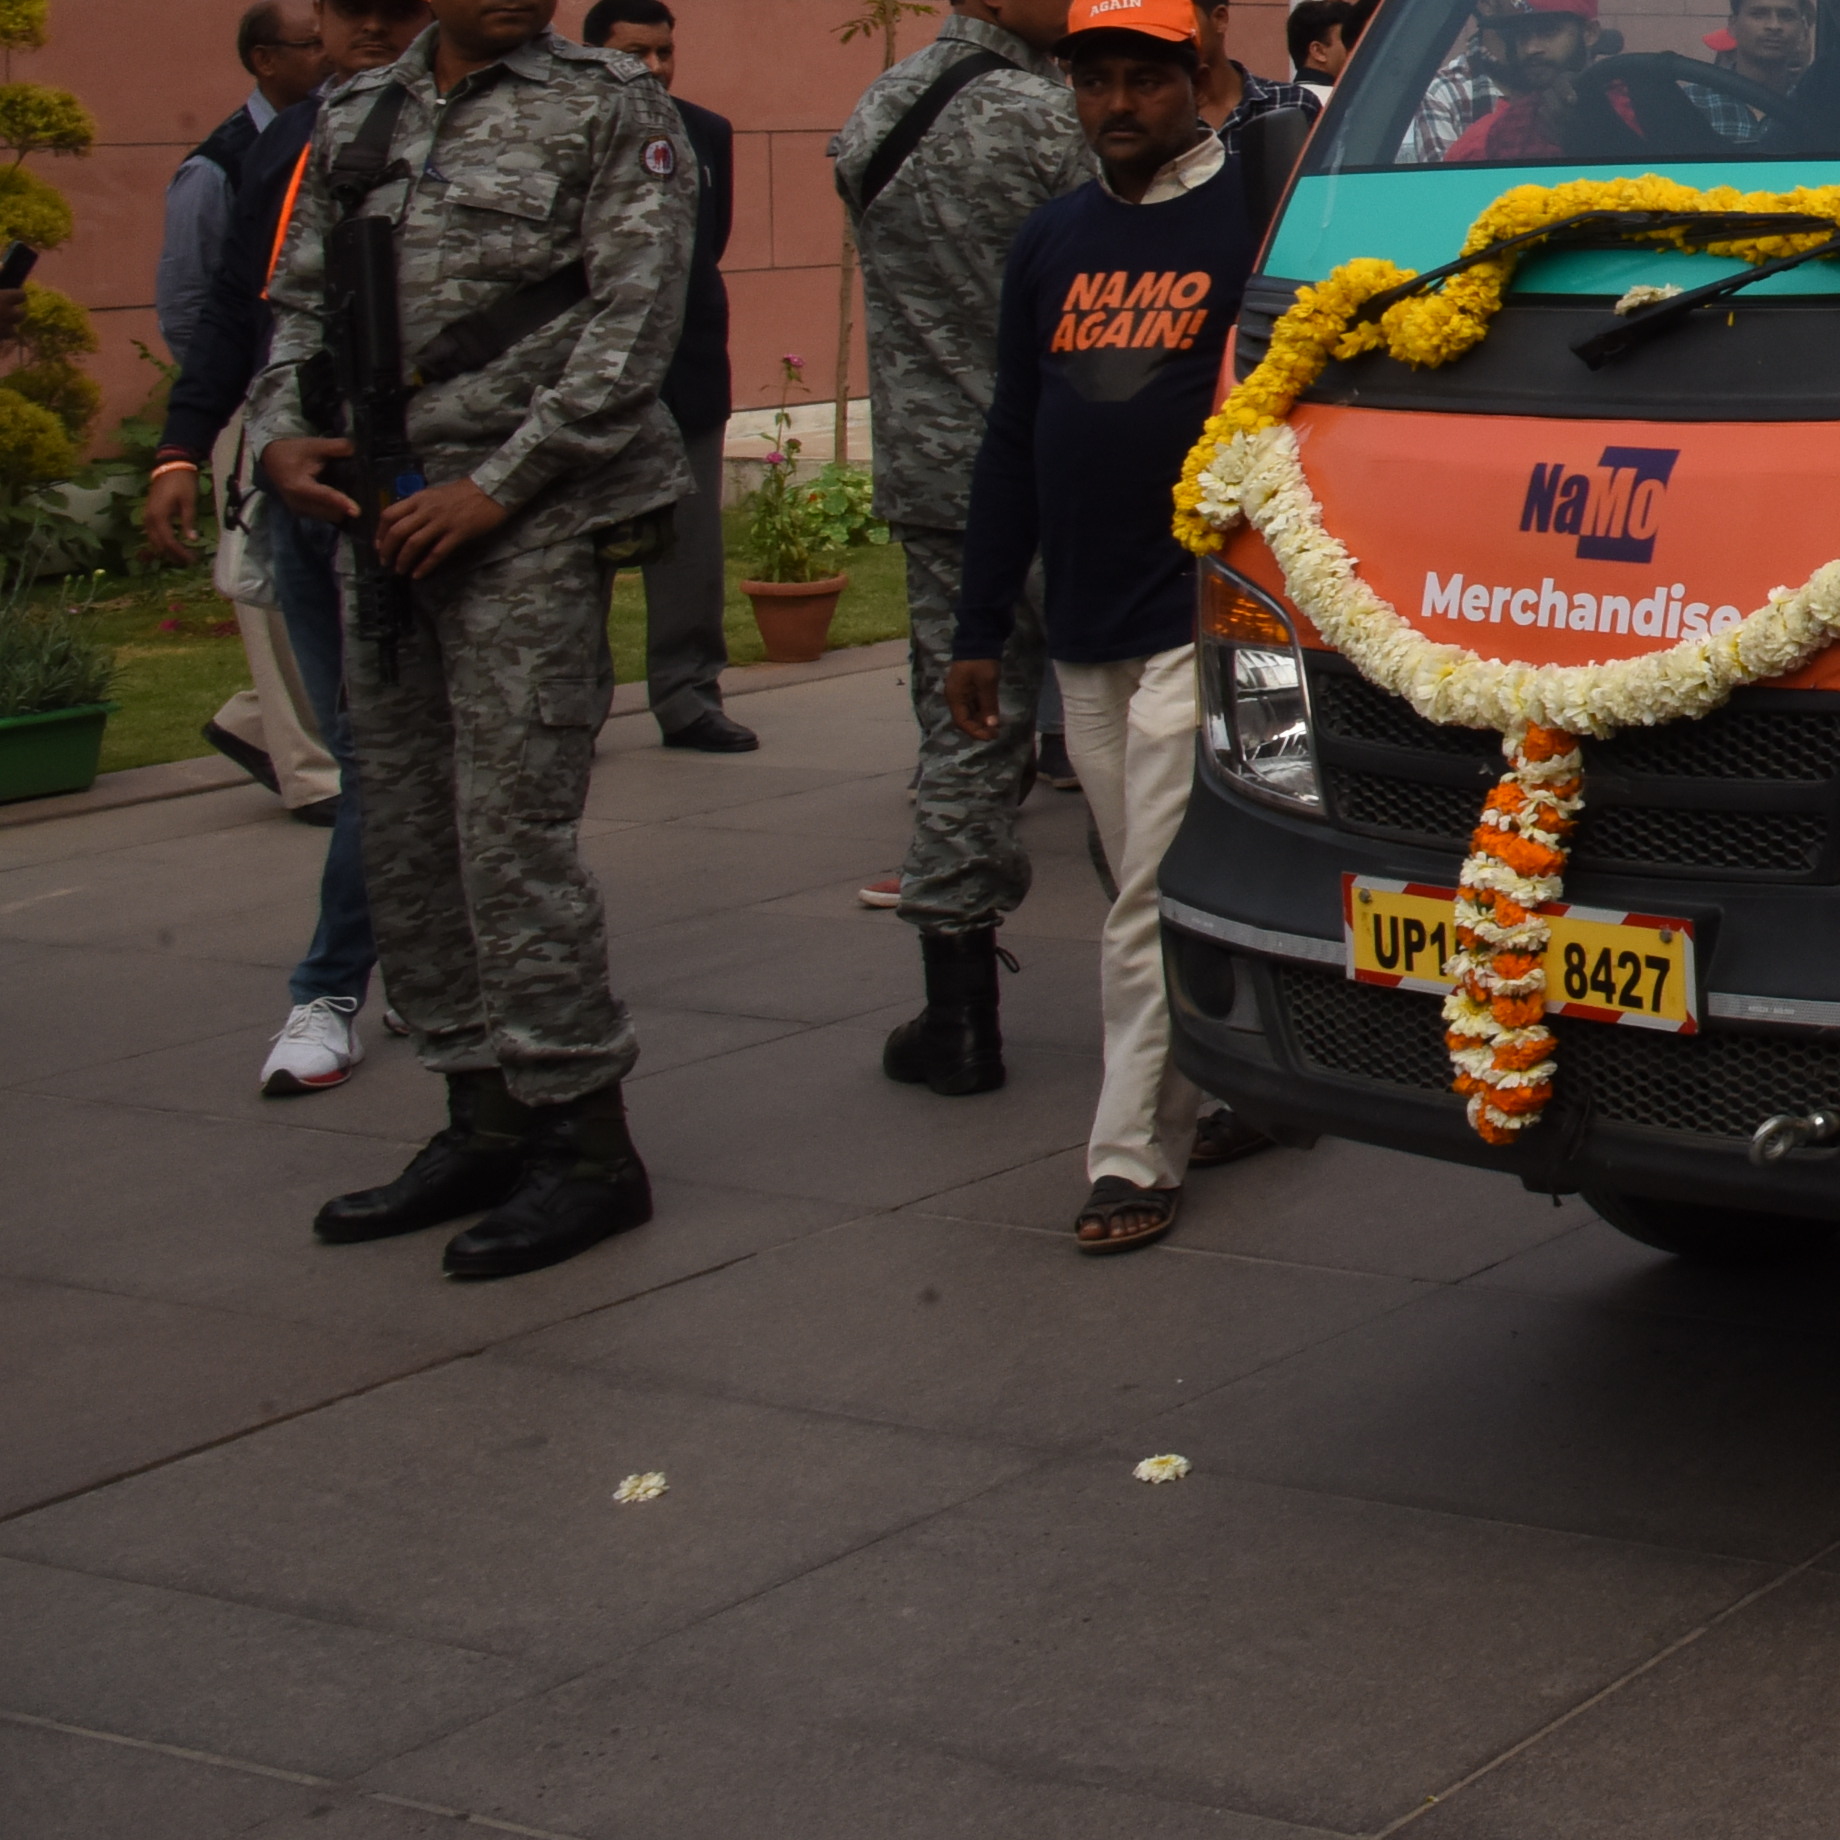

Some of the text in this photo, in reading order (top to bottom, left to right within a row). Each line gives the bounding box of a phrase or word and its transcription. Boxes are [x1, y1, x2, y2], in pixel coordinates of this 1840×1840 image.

[1062, 271, 1211, 311] NAMO
[1051, 309, 1208, 352] AGAIN!
[1519, 446, 1680, 564] NaMo
[1421, 571, 1742, 640] Merchandise
[1563, 942, 1670, 1013] 8427
